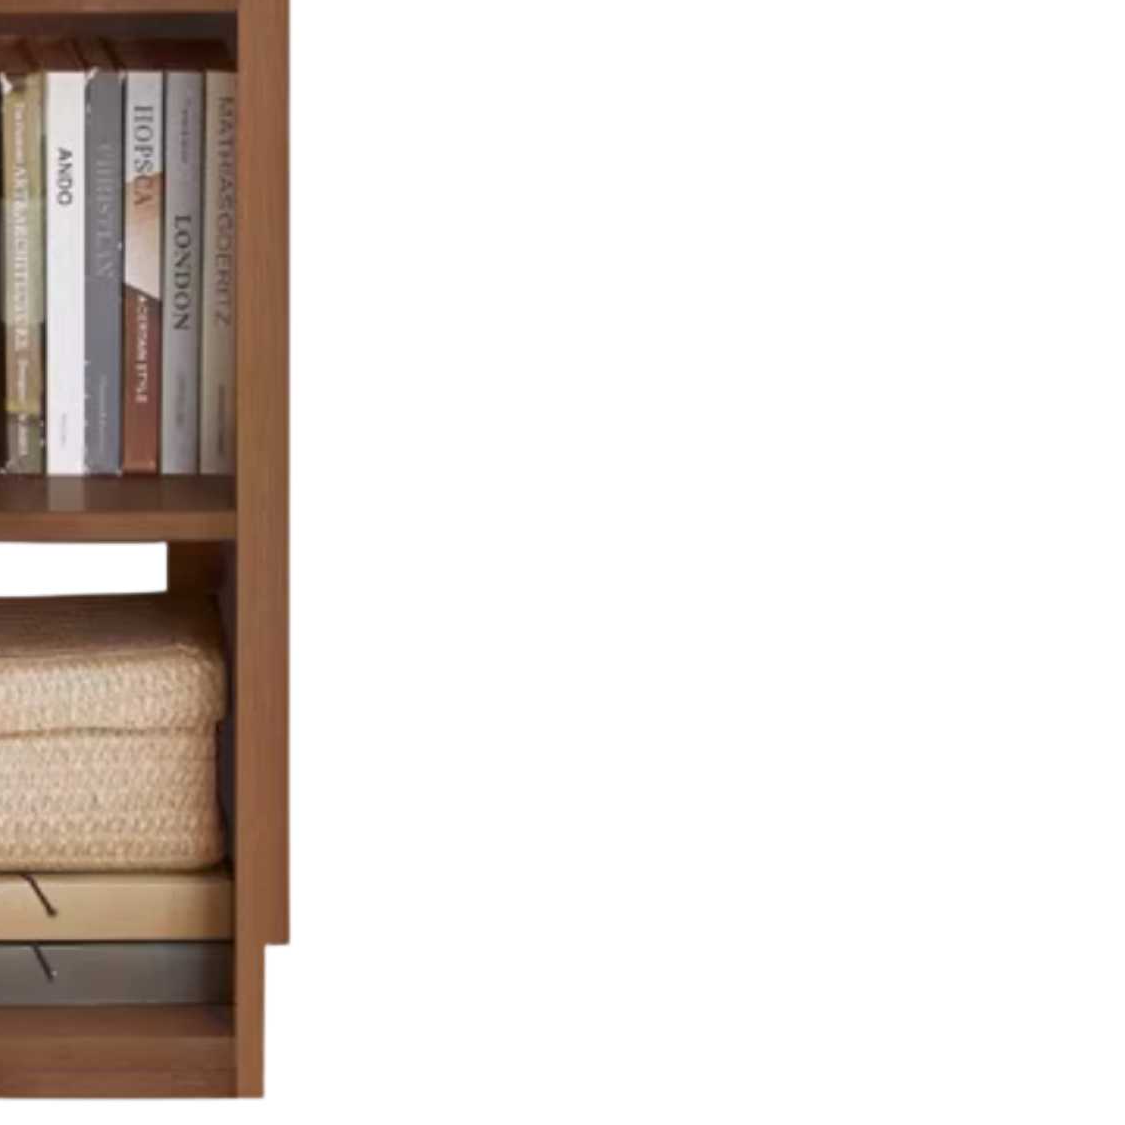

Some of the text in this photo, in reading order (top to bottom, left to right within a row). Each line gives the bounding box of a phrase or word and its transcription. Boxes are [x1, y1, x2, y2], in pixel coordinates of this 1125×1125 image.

[57, 147, 73, 206] ANDO
[133, 105, 154, 206] HOPSCA
[174, 215, 191, 331] LONDON
